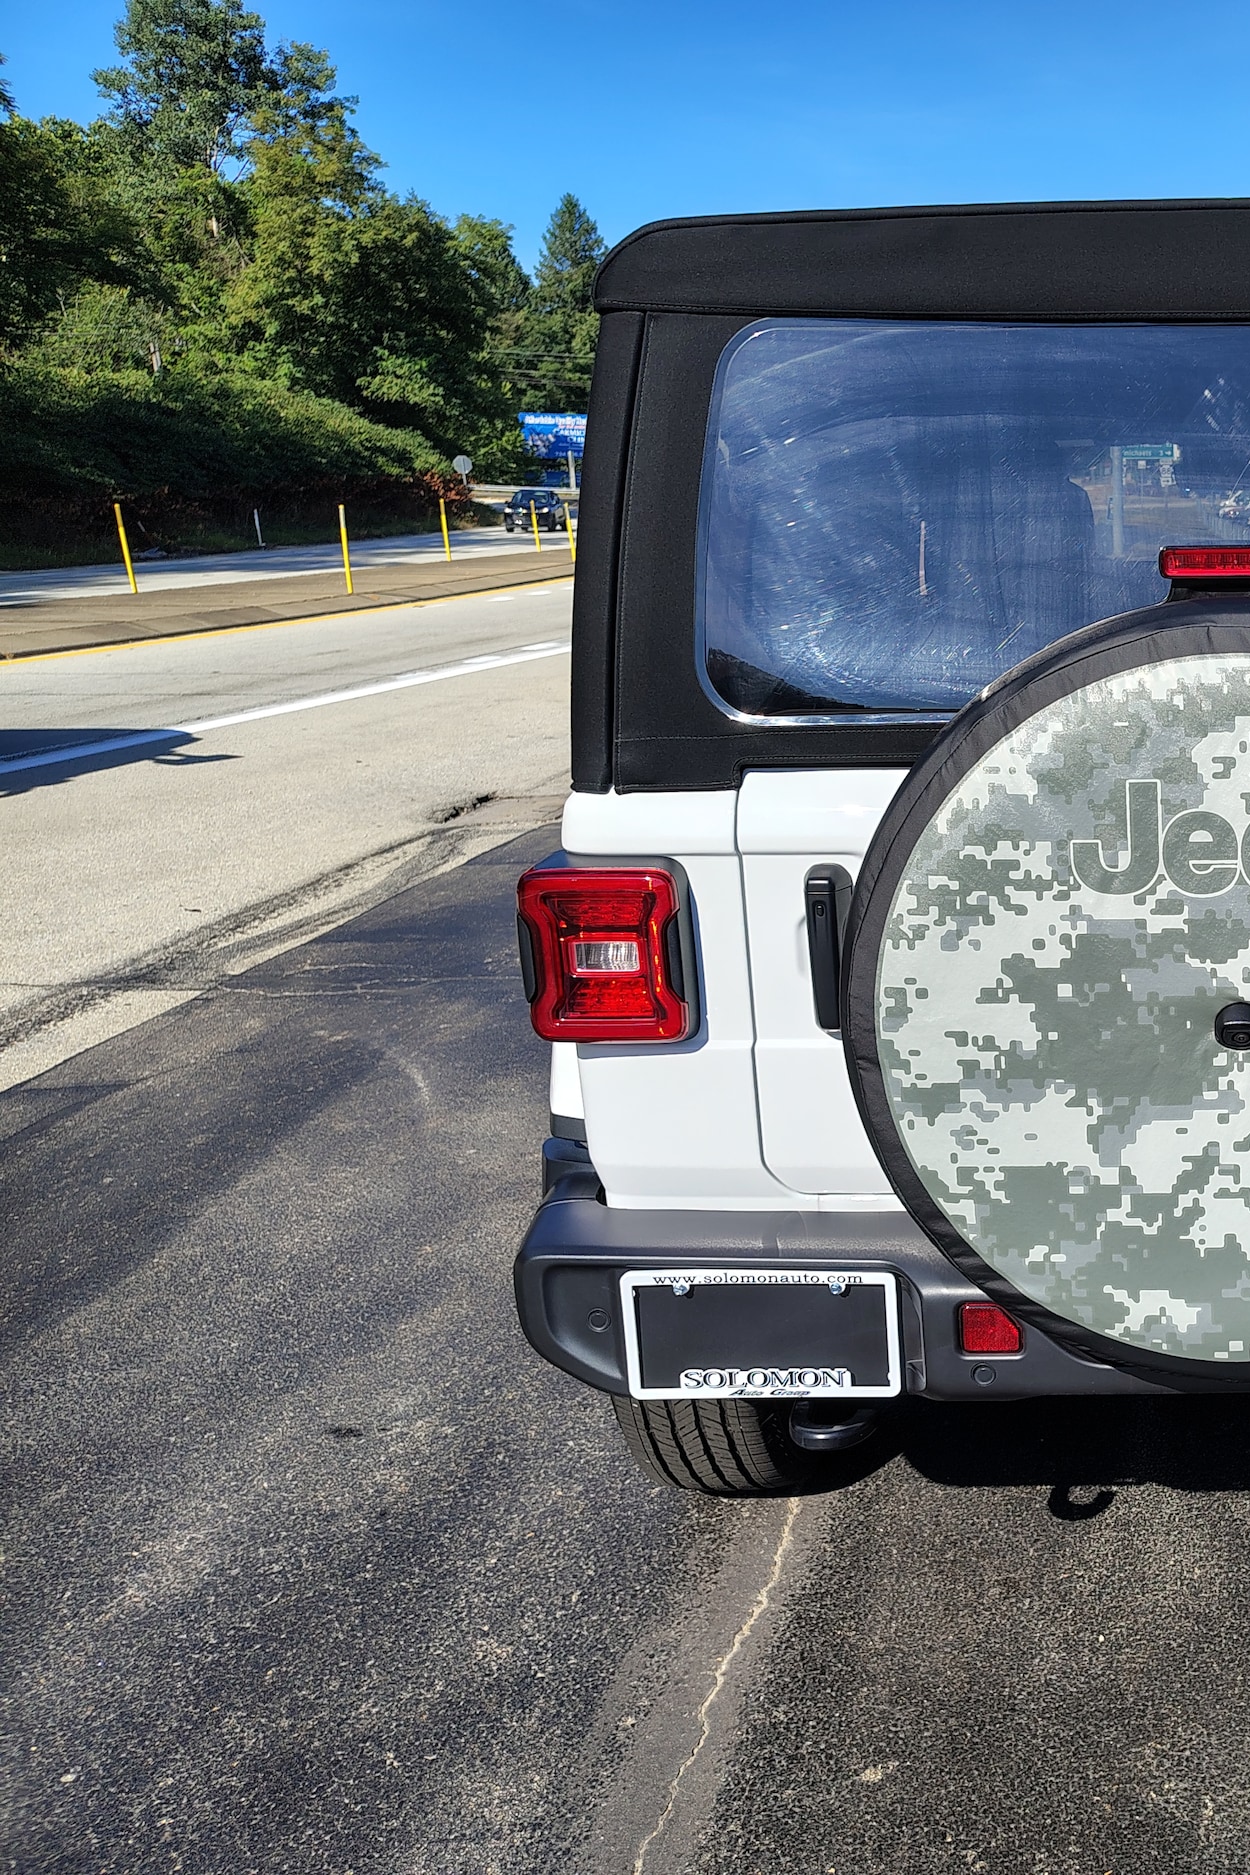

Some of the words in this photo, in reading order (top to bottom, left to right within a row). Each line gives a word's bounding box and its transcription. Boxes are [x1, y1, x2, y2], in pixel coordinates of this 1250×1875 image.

[653, 1272, 864, 1285] www.solomonauto.com
[684, 1369, 847, 1389] SOLOMON
[729, 1388, 764, 1397] Auto
[769, 1388, 811, 1397] Group
